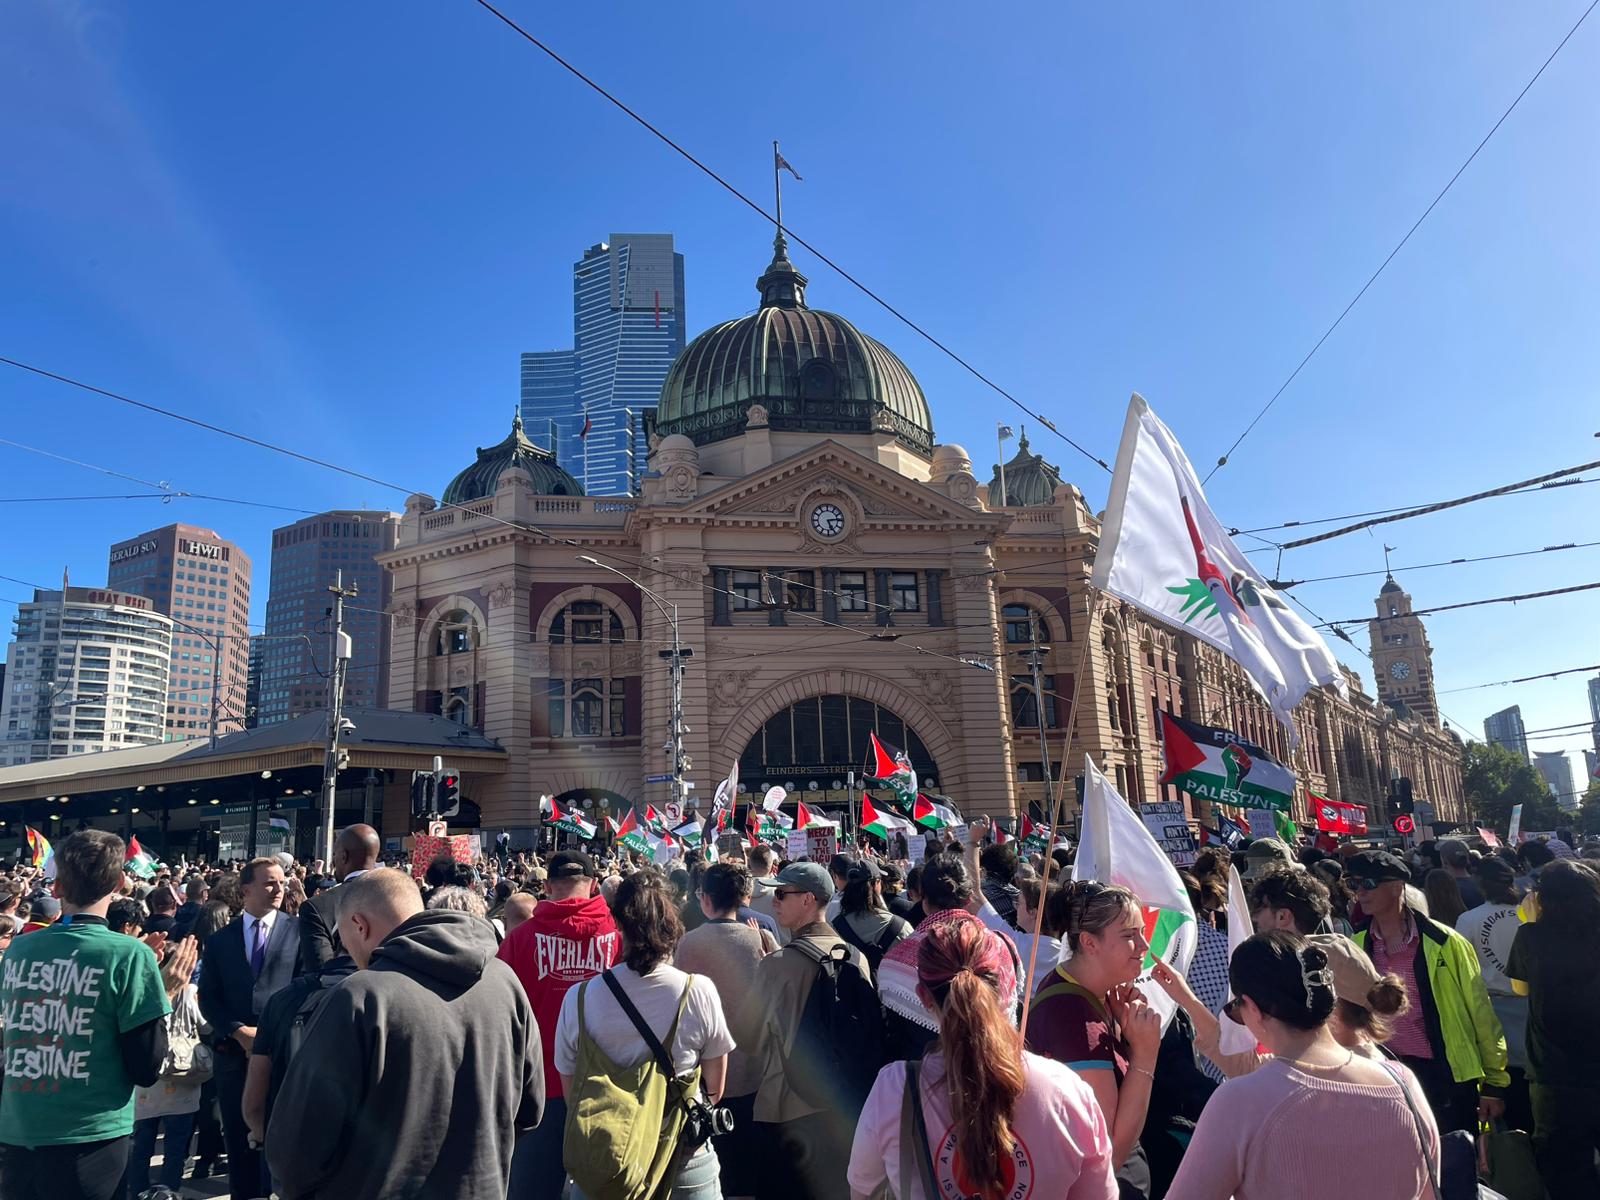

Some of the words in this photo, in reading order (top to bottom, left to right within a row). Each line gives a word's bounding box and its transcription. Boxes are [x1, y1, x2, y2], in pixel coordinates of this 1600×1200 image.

[140, 540, 158, 552] SUN
[189, 541, 219, 558] HWT
[766, 767, 812, 775] FLINDERS
[815, 838, 828, 847] TO
[813, 847, 830, 855] THE
[535, 932, 616, 980] EVERLAST
